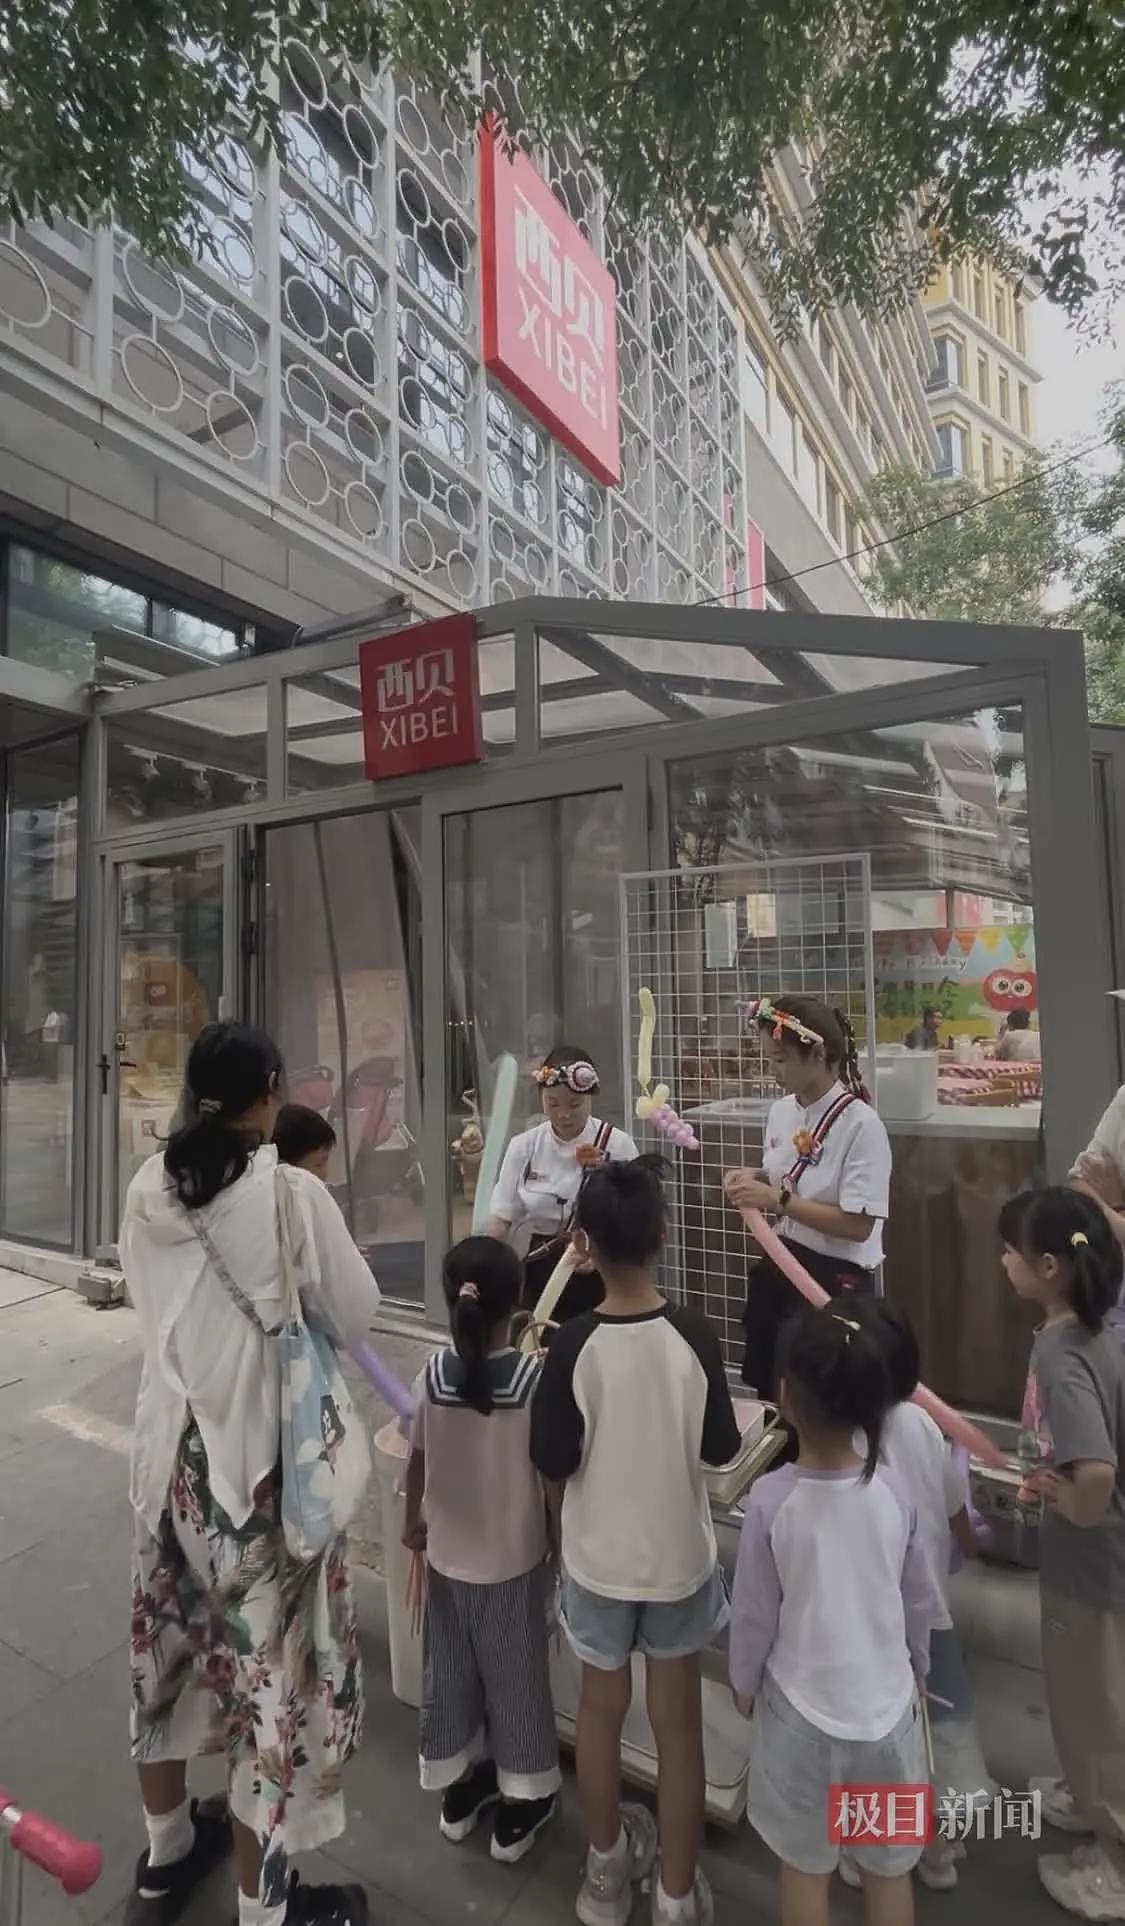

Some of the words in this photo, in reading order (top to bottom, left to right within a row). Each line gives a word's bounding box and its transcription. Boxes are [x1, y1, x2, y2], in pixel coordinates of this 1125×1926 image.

[514, 184, 604, 368] 西贝
[519, 284, 608, 431] XIBEI
[376, 648, 455, 713] 西贝
[380, 702, 459, 750] XIBEI
